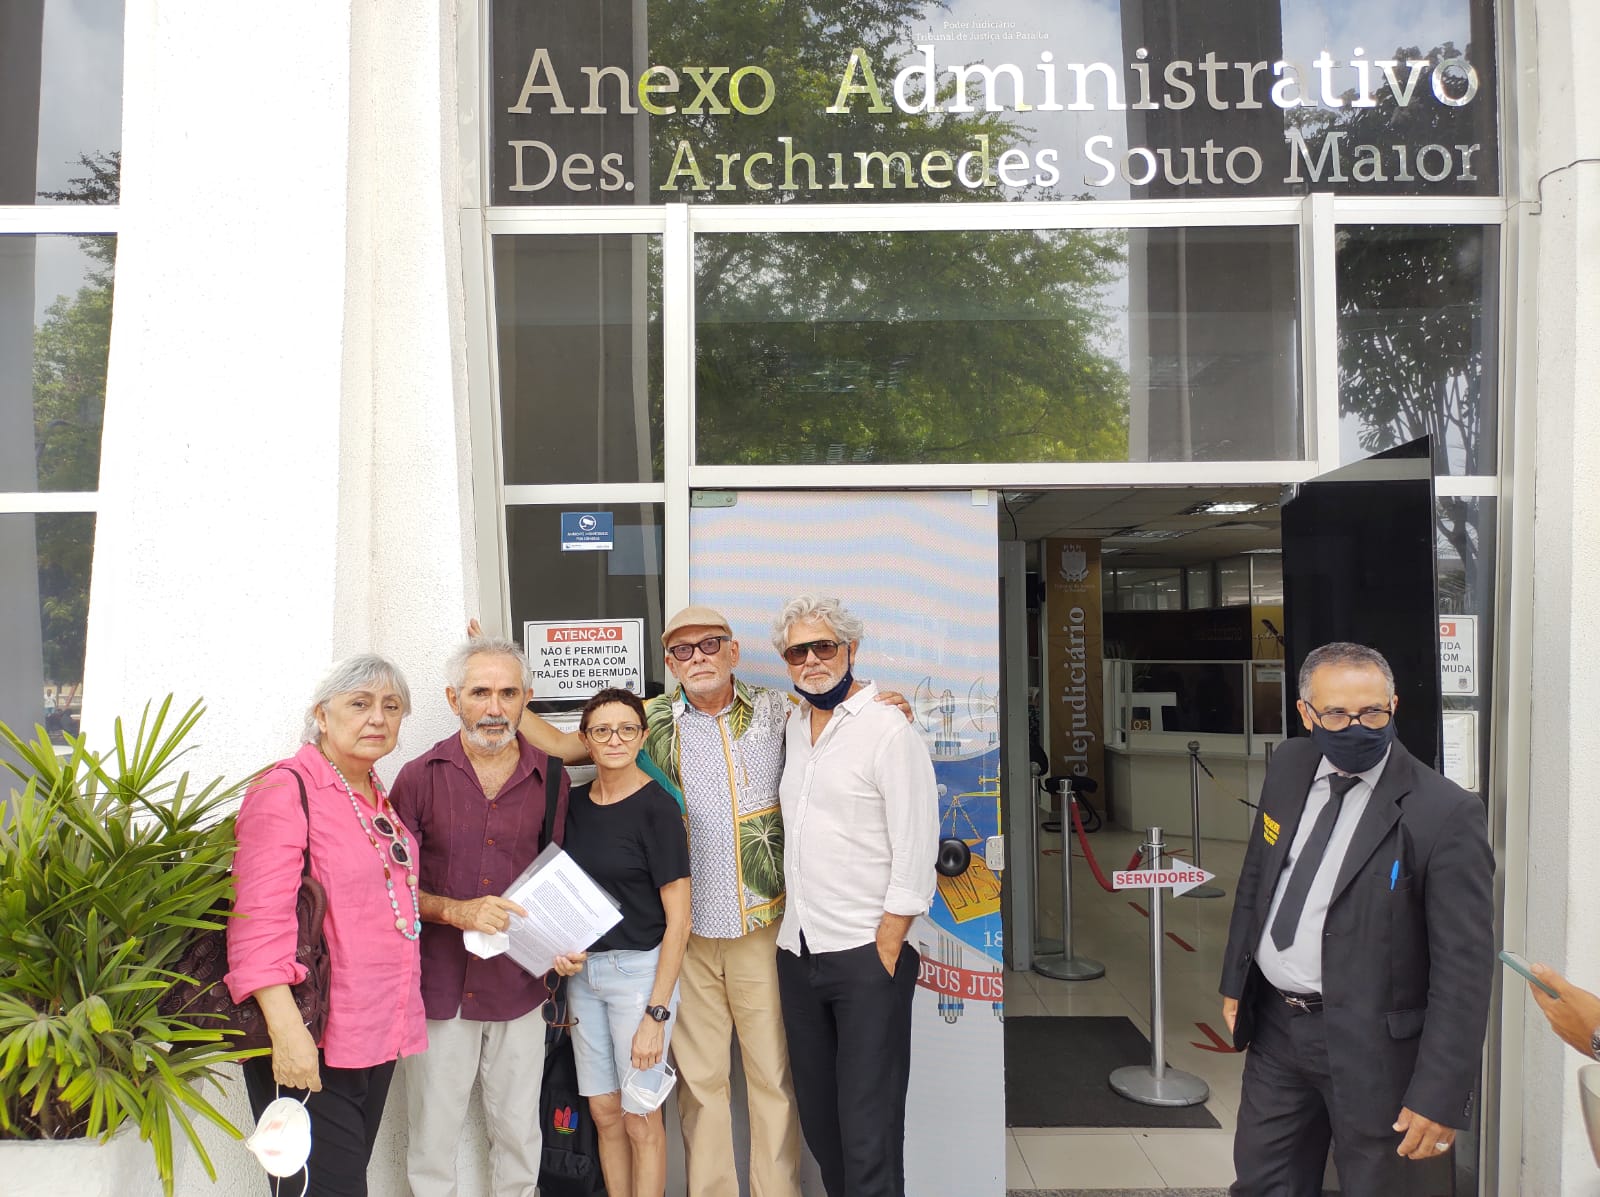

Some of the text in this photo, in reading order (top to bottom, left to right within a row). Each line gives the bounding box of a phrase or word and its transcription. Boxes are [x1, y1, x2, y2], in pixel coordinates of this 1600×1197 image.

[943, 21, 969, 29] Poder
[916, 32, 954, 41] Tribunal
[956, 31, 968, 40] de
[1002, 31, 1013, 40] da
[507, 45, 1479, 117] Anexo Administrativo
[508, 139, 634, 192] Des.
[1083, 134, 1263, 187] Souto
[553, 627, 617, 641] ATENÇÃO
[540, 645, 628, 656] NÃO É PERMITIDA
[553, 658, 600, 667] ENTRADA
[603, 656, 626, 665] COM
[1440, 653, 1459, 662] OM
[532, 667, 638, 679] TRAJES DE BERMUDA
[558, 680, 573, 689] OU
[1116, 871, 1205, 885] SERVIDORES
